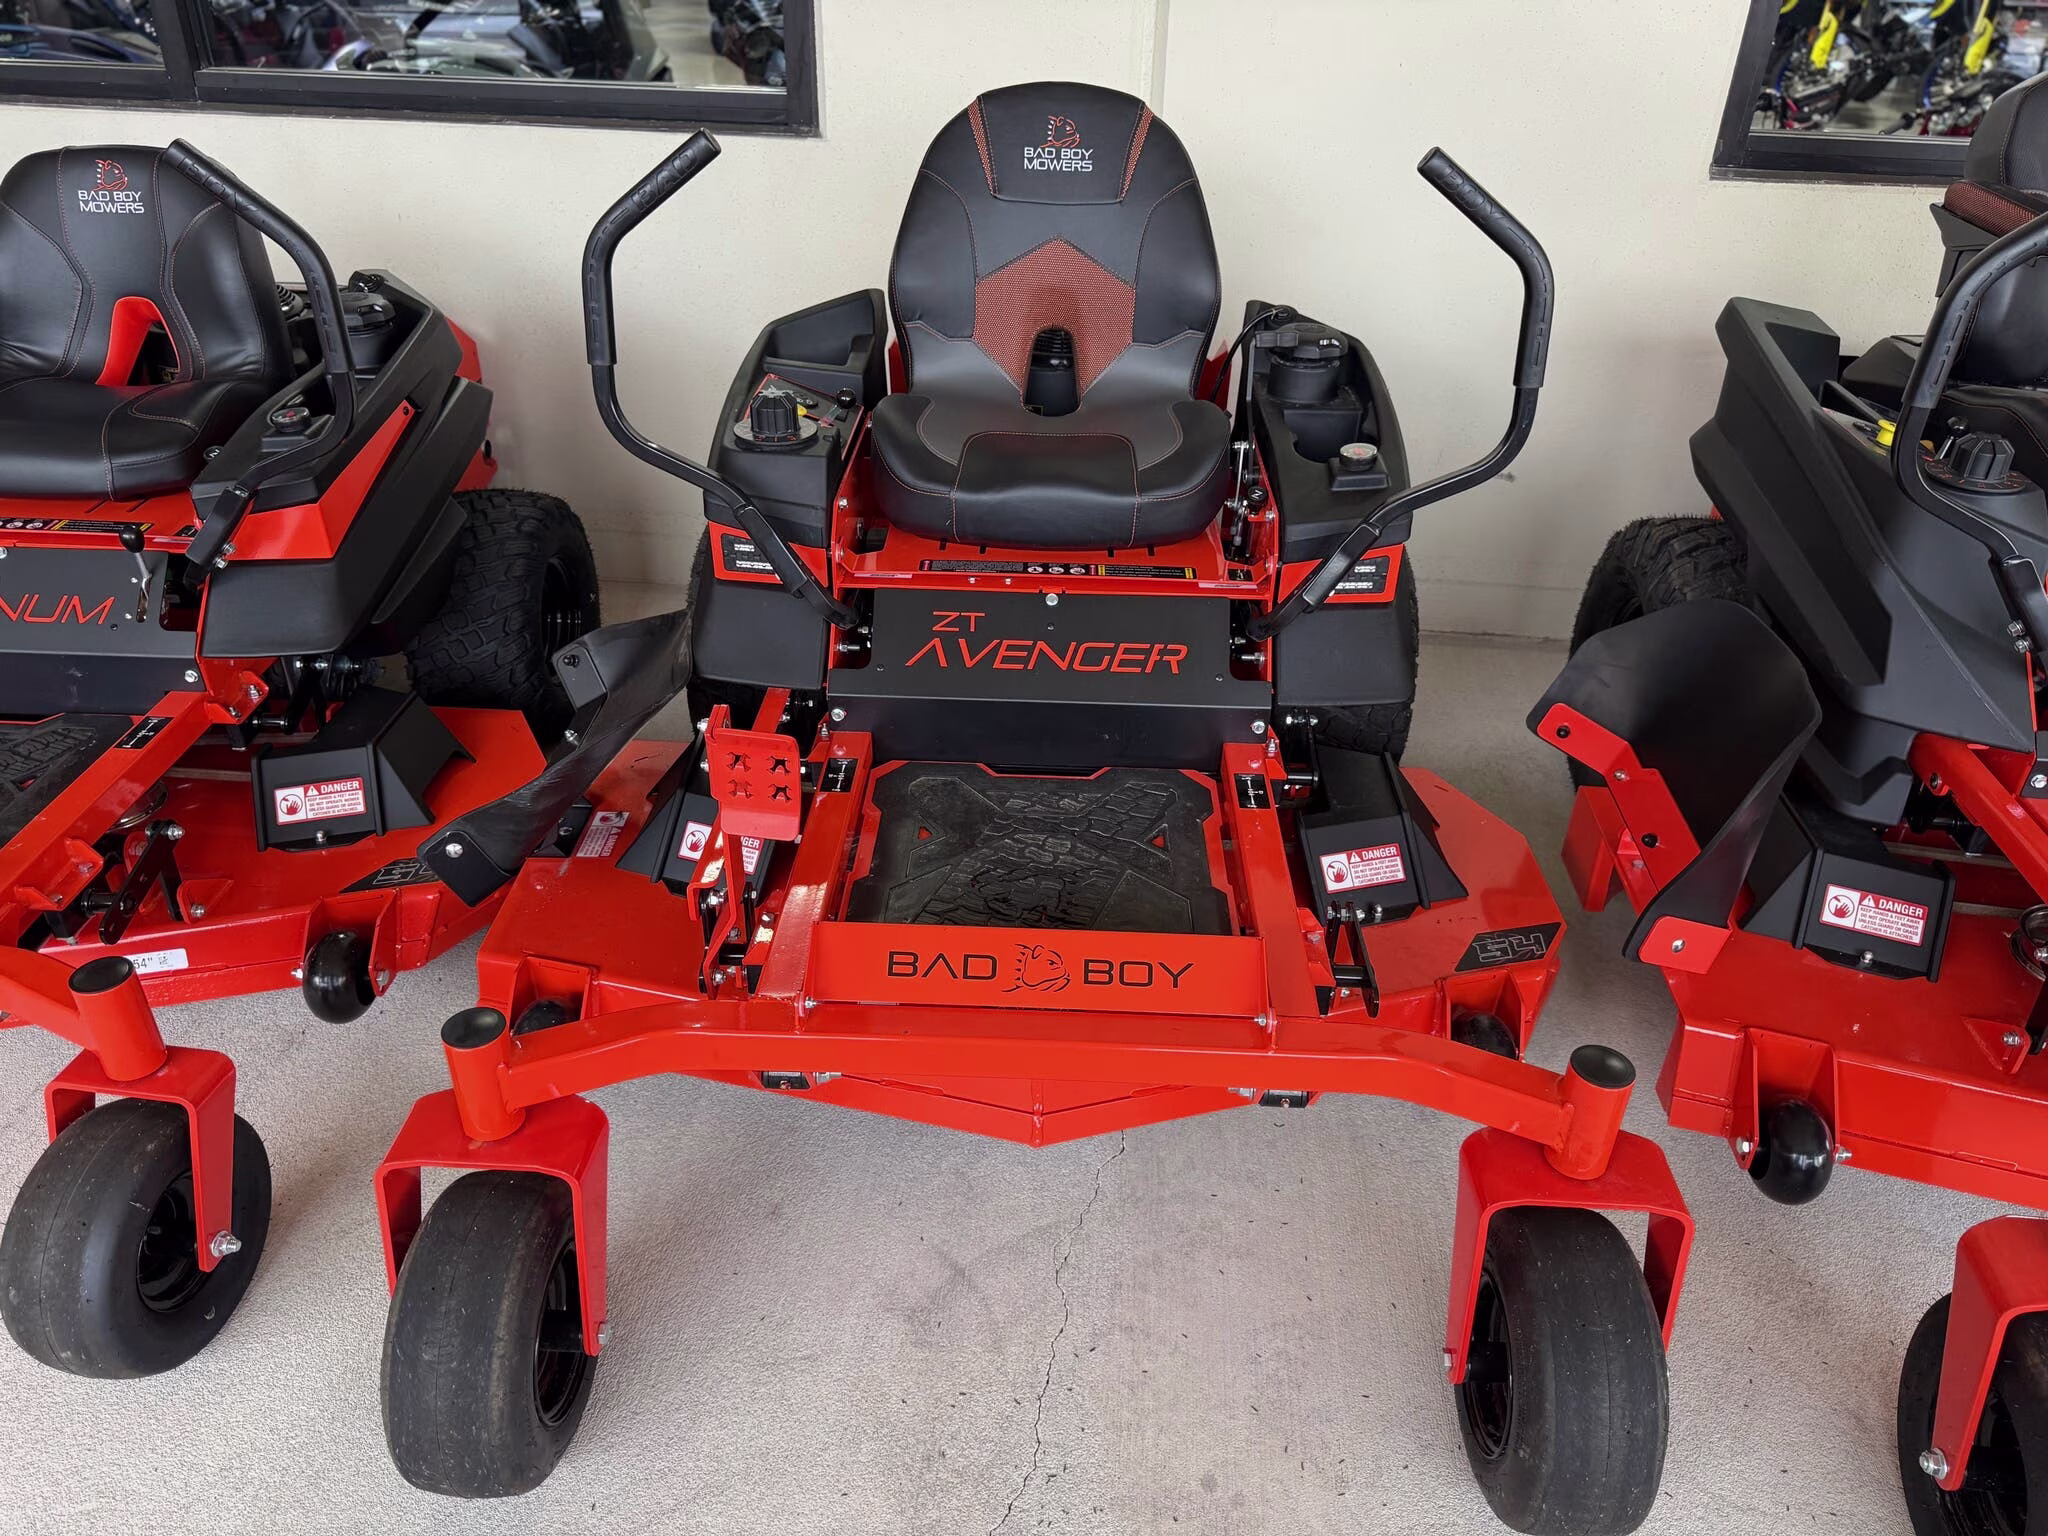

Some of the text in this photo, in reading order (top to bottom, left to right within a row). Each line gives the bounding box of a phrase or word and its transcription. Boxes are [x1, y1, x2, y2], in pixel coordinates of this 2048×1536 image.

[1024, 147, 1093, 160] BAD BOY
[1024, 158, 1093, 172] MOWERS
[78, 190, 142, 202] BAD BOY
[79, 201, 145, 214] MOWERS
[932, 611, 985, 632] ZT
[905, 637, 1188, 674] AVENGER
[320, 781, 360, 794] DANGER
[1361, 846, 1397, 860] DANGER
[1878, 898, 1923, 918] DANGER
[1472, 933, 1546, 962] 54
[887, 950, 1194, 989] BAD BOY
